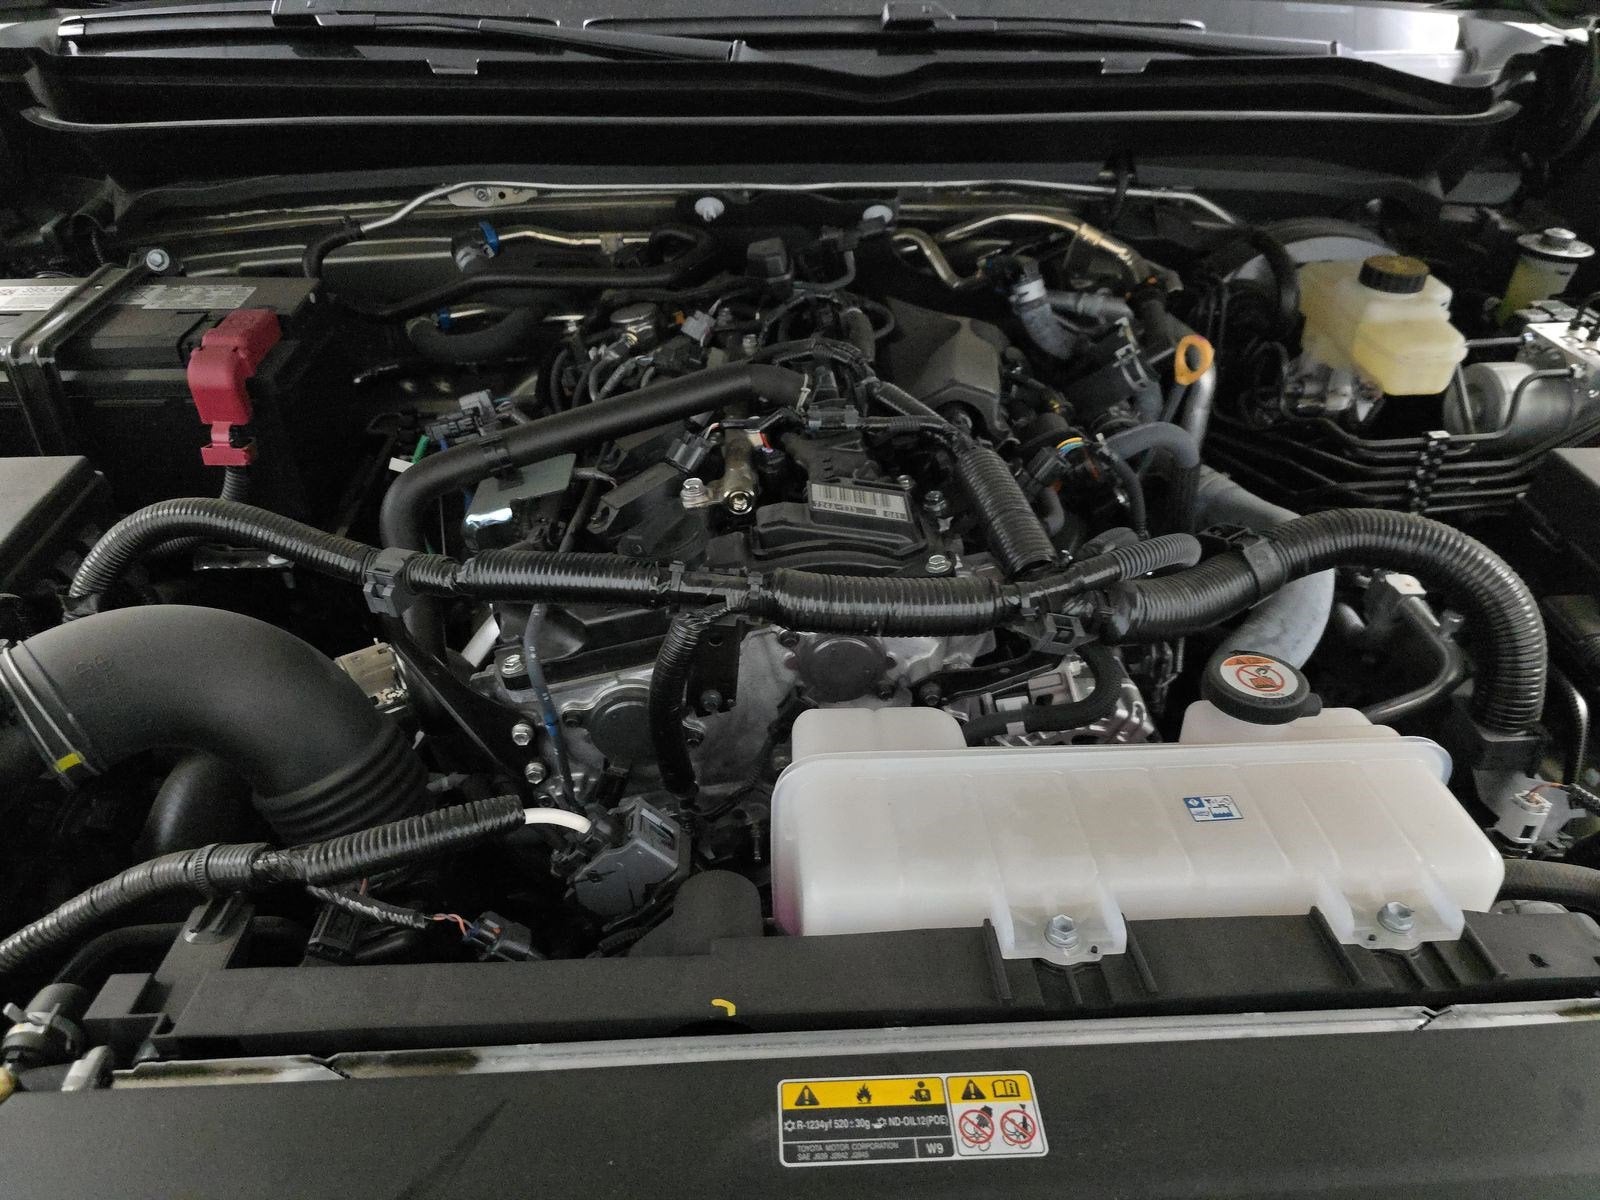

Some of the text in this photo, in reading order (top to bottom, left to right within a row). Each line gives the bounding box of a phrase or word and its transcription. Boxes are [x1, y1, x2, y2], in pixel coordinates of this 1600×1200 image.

[796, 1120, 833, 1131] R-1234yf
[797, 1140, 899, 1153] TOYOTA MOTOR CORPORATION
[925, 1142, 944, 1155] W9
